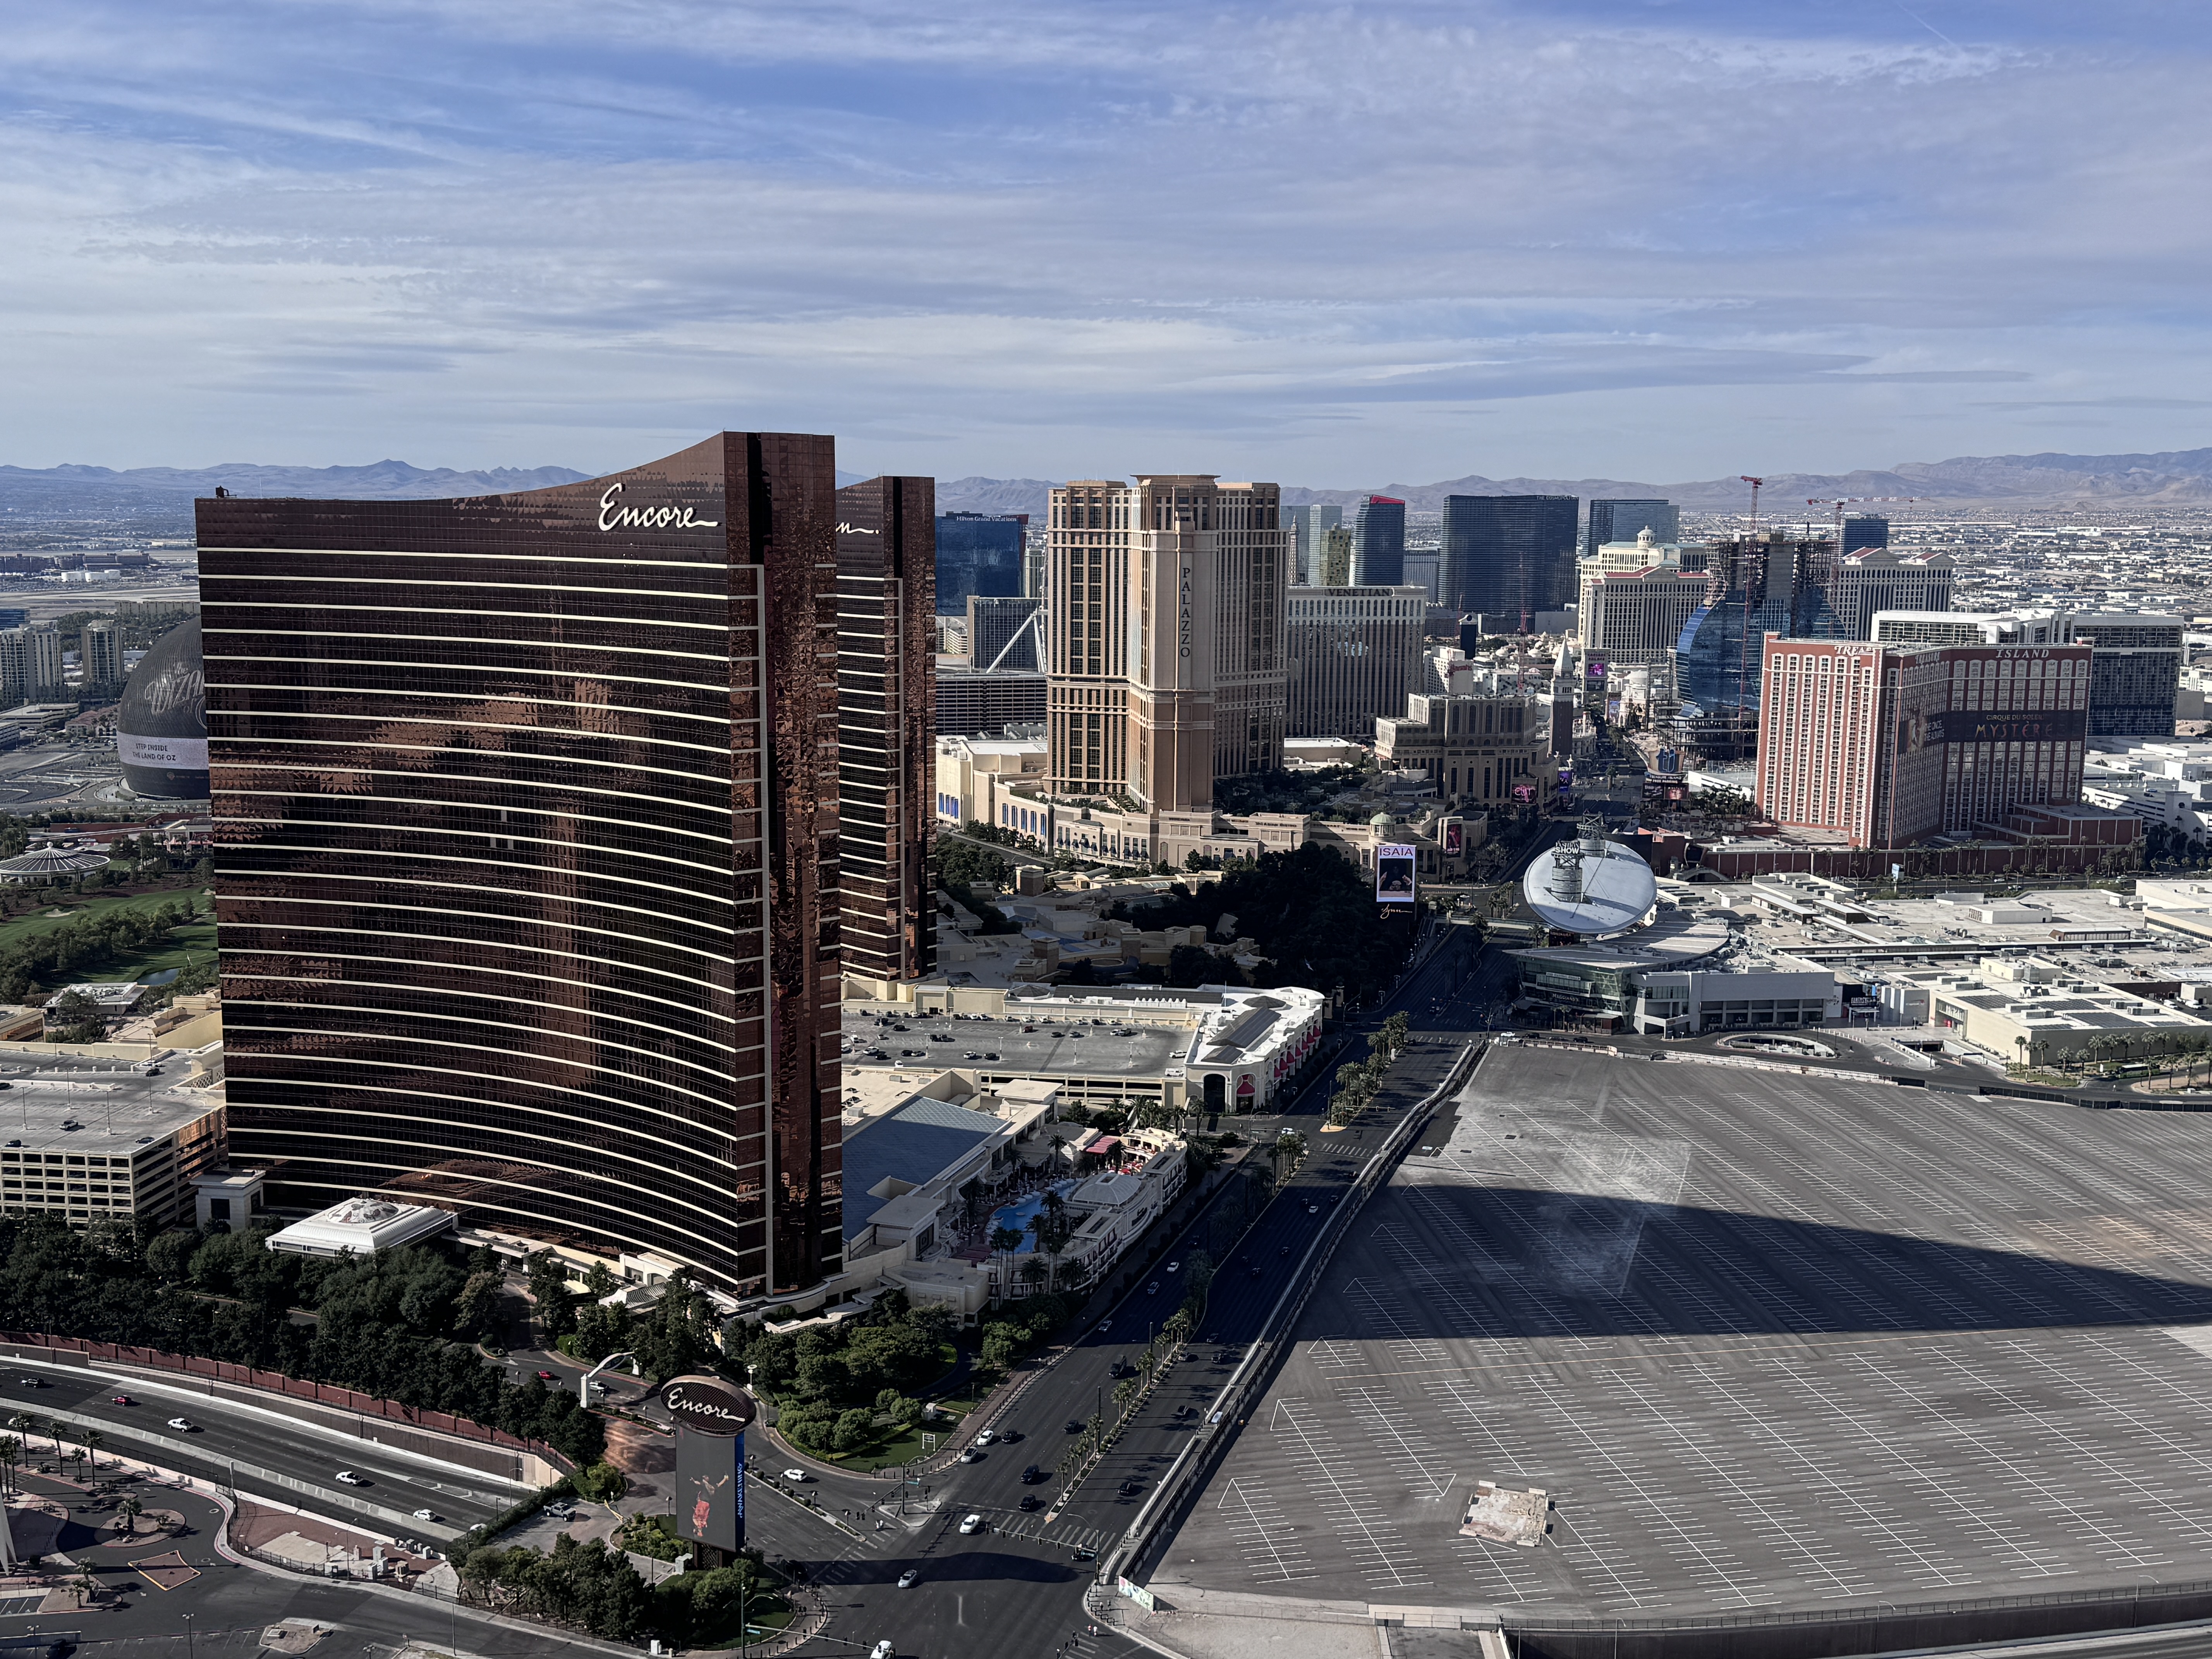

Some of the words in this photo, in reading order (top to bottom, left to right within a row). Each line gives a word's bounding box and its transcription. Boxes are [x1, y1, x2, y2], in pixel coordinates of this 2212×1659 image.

[599, 483, 718, 531] Encore
[1180, 568, 1190, 657] PALAZZO
[1996, 649, 2049, 658] ISLAND
[1975, 721, 2052, 738] MYSTÈRE
[1380, 848, 1413, 856] ISAIA
[668, 1387, 745, 1422] Encore
